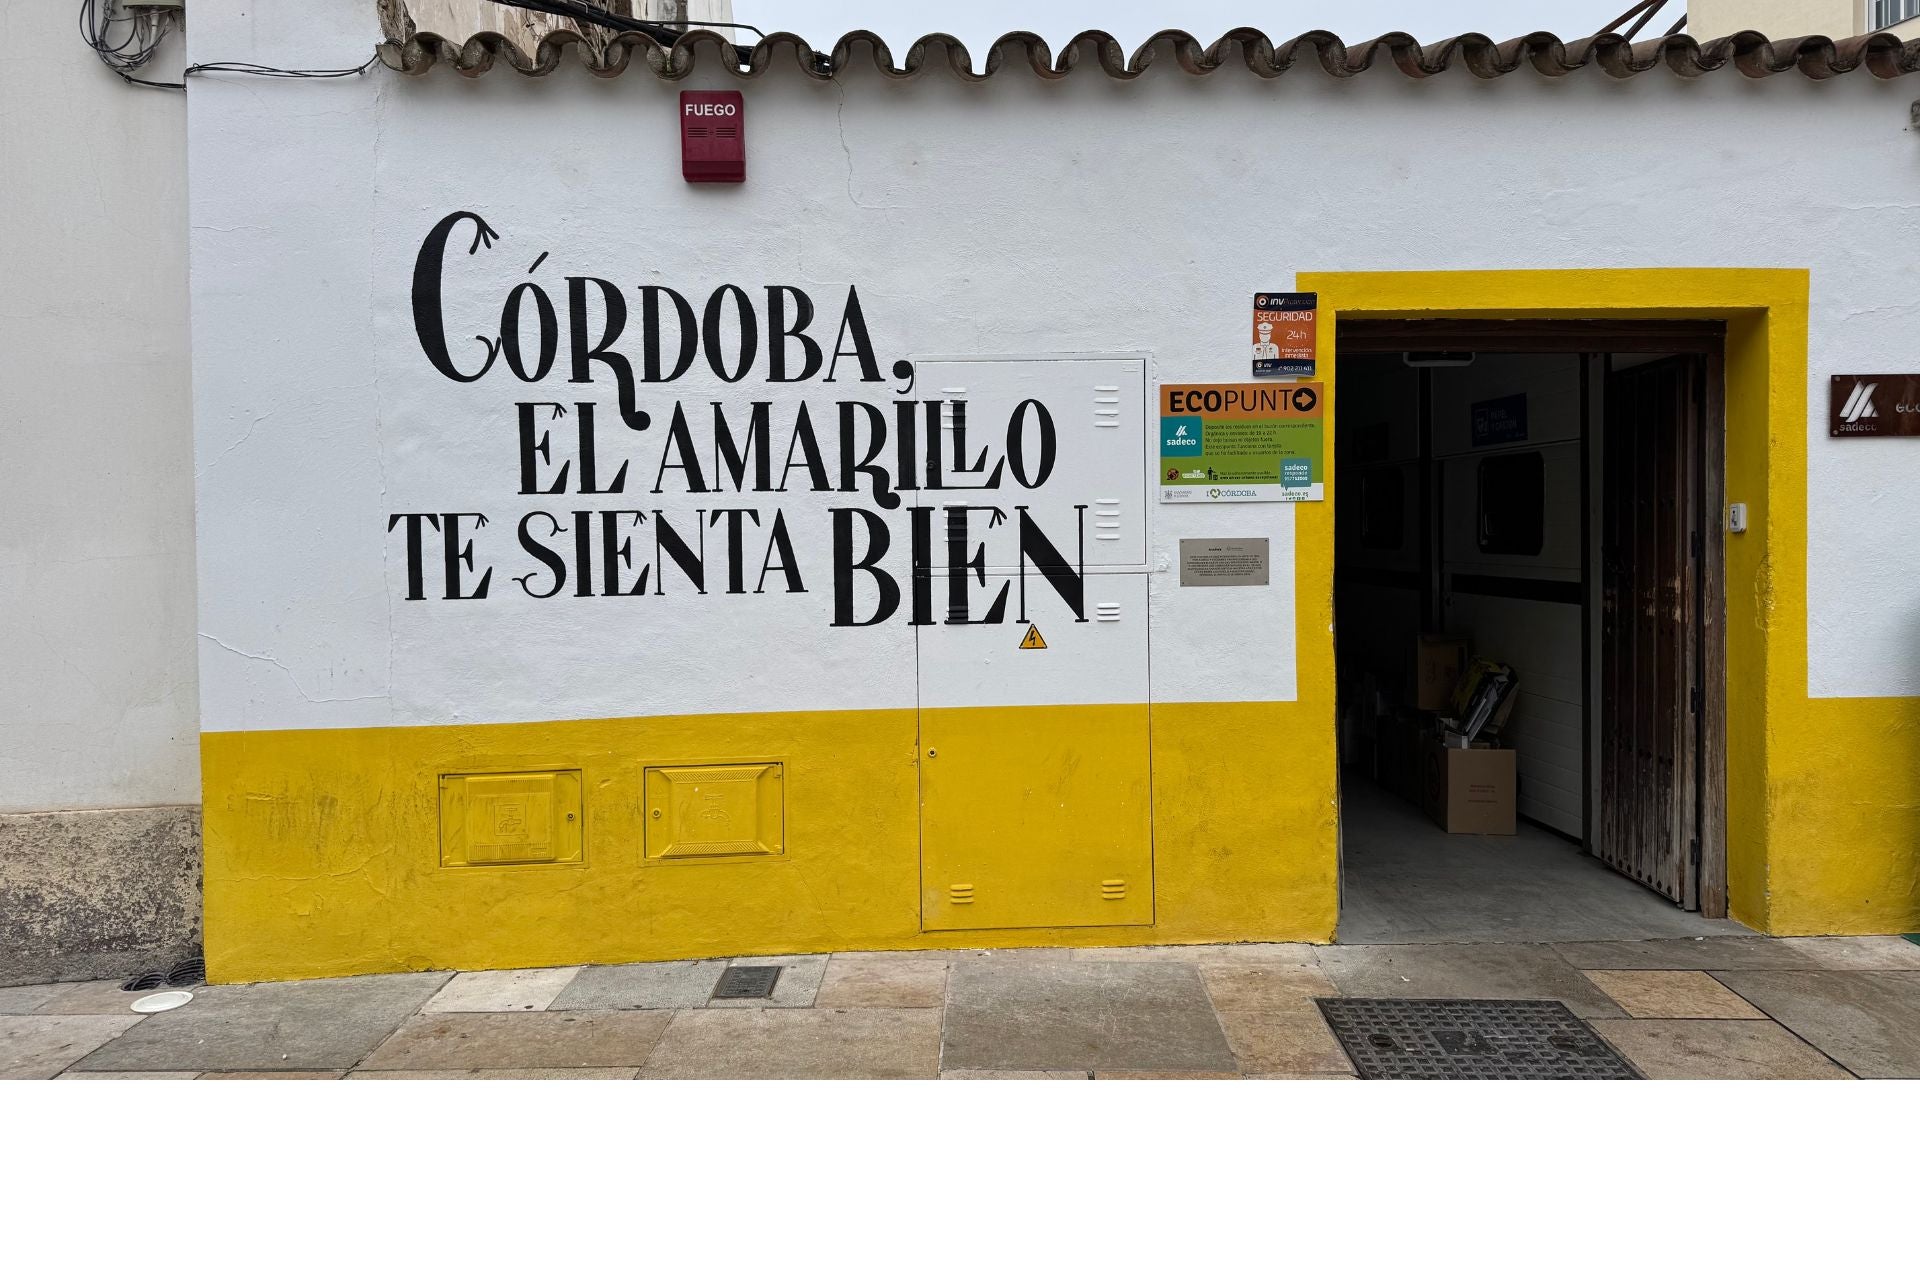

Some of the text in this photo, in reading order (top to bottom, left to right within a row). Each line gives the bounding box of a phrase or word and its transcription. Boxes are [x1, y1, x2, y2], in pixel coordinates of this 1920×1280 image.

[685, 103, 736, 116] FUEGO
[411, 210, 915, 431] CÓRDOBA,
[1257, 311, 1312, 321] SEGURIDAD
[1839, 422, 1877, 432] sadeco
[1166, 437, 1197, 446] sadeco
[515, 398, 1057, 510] EL AMARILLO
[1284, 463, 1308, 471] sadeco
[387, 504, 1090, 628] TE SIENTA BIEN
